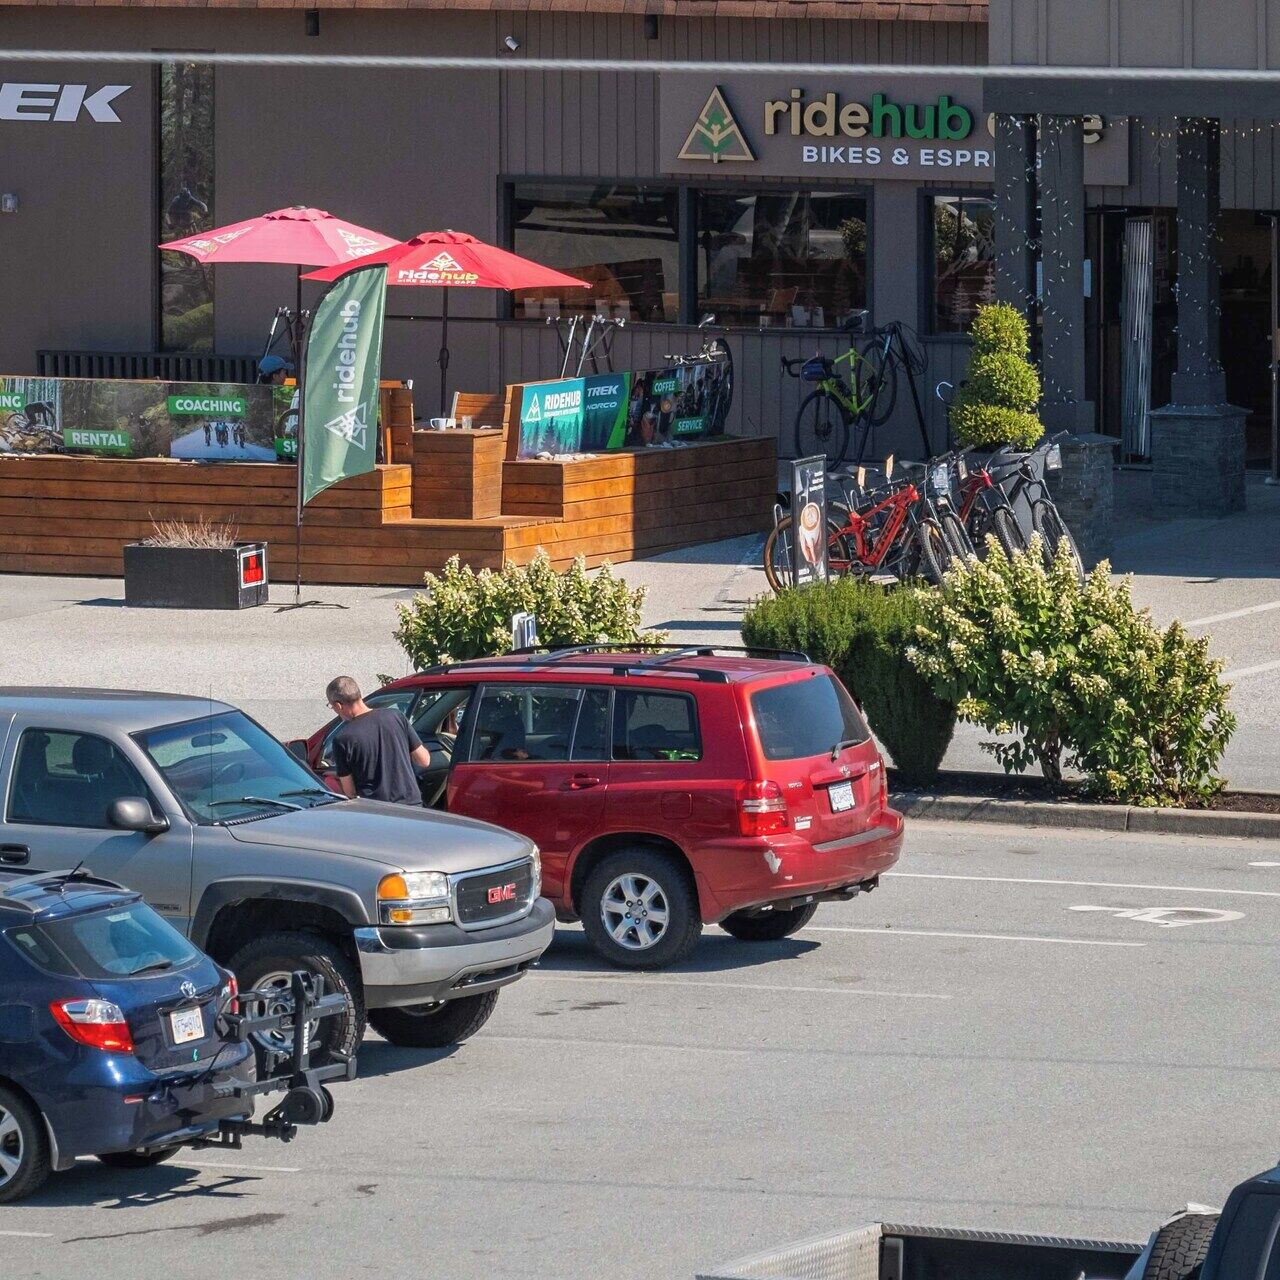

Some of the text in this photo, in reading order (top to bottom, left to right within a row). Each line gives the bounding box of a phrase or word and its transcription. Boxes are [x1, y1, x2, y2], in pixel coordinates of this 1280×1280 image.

[763, 88, 971, 141] ridehub
[802, 146, 995, 167] BIKES & ESPR
[398, 270, 479, 281] ridehub
[333, 300, 362, 402] ridehub
[587, 385, 618, 397] TREK
[654, 381, 675, 392] COFFEE
[175, 399, 242, 413] COACHING
[544, 390, 581, 410] RIDEHUB
[586, 401, 617, 410] NORCO
[677, 419, 703, 431] SERVICE
[71, 432, 126, 448] RENTAL
[488, 883, 516, 904] GMC
